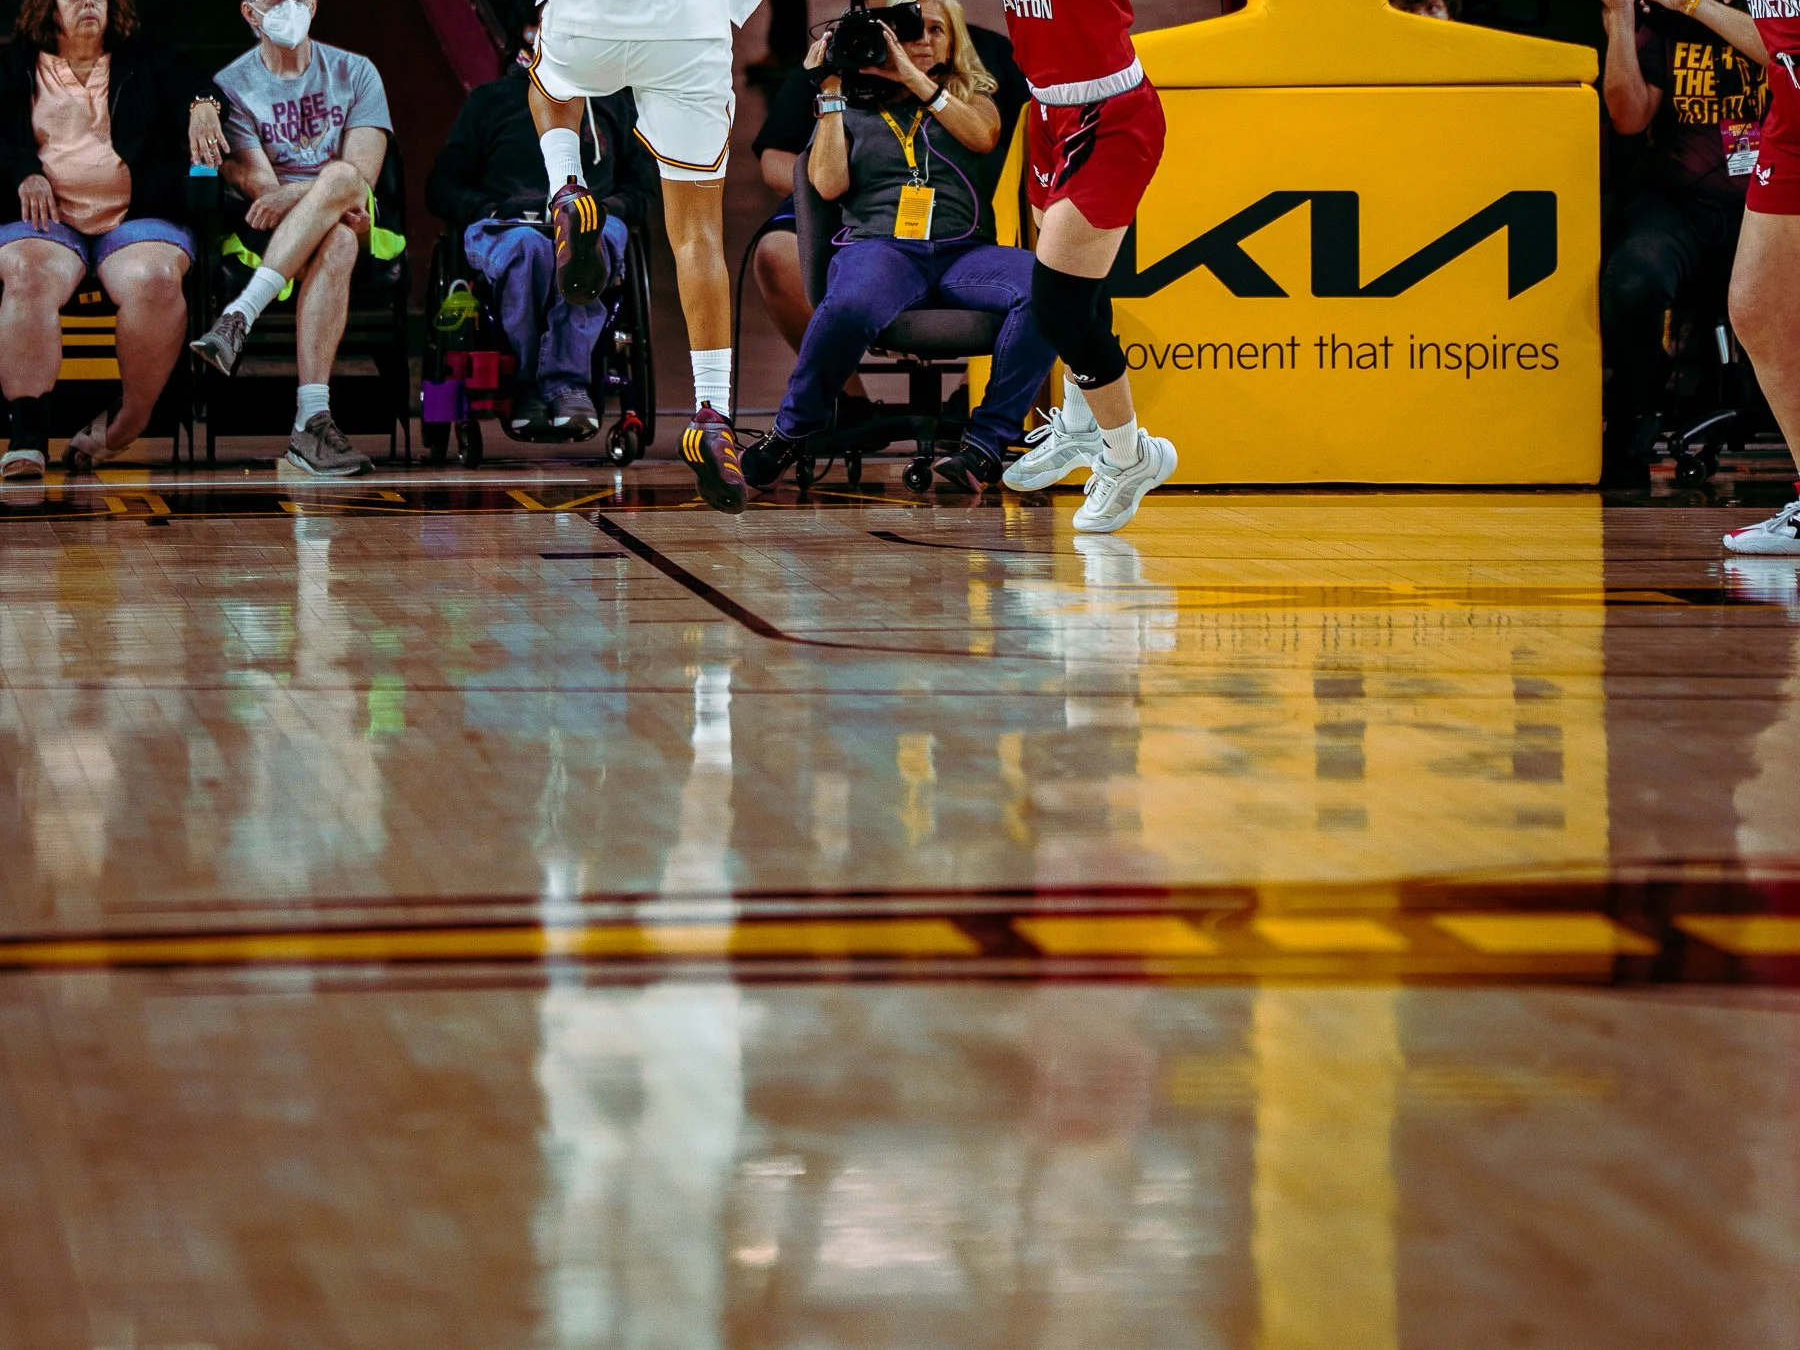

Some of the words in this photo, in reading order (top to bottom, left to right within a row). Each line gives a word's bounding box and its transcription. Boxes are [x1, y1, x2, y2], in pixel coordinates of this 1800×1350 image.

[1673, 69, 1717, 97] THE
[272, 92, 329, 124] PAGE
[1115, 334, 1301, 370] ovement
[1314, 333, 1394, 370] that
[1409, 334, 1560, 379] inspires
